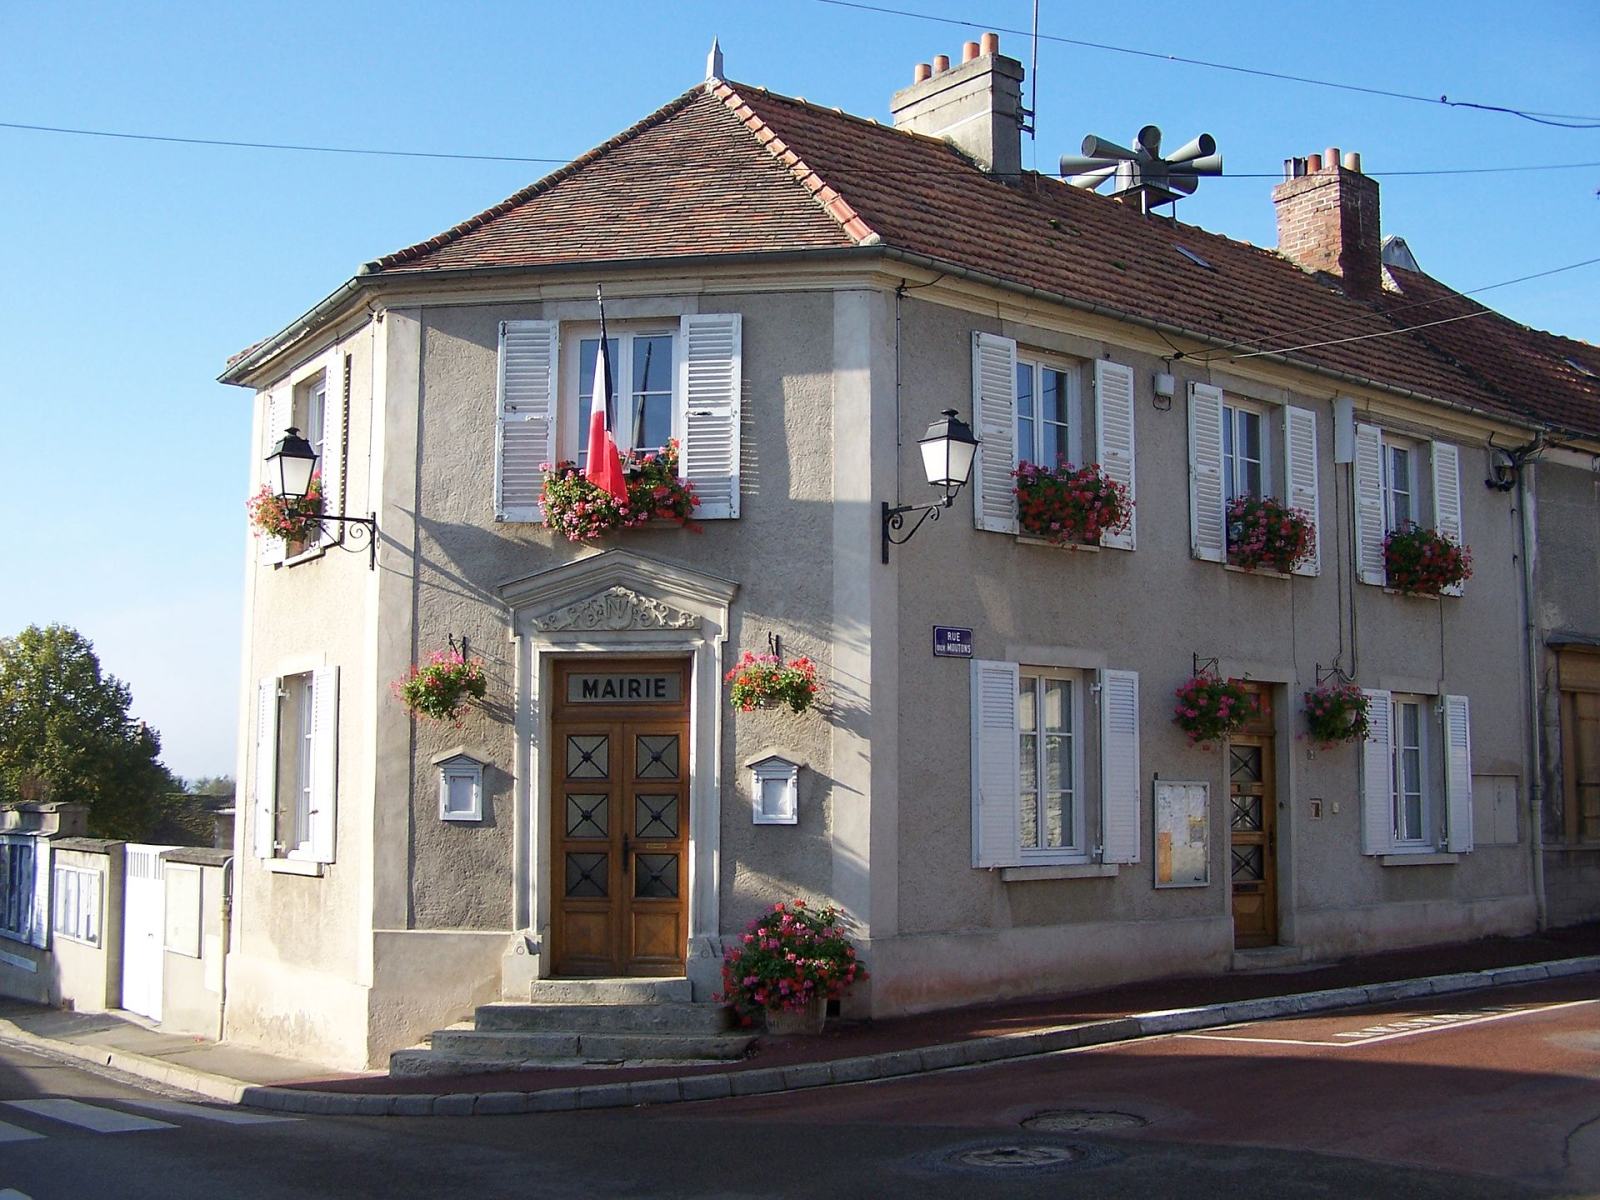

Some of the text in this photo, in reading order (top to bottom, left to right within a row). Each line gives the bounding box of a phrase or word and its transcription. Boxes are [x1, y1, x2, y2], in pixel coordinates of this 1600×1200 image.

[947, 632, 960, 641] RUE
[947, 643, 971, 653] MOUTONS
[582, 678, 666, 698] MAIRIE
